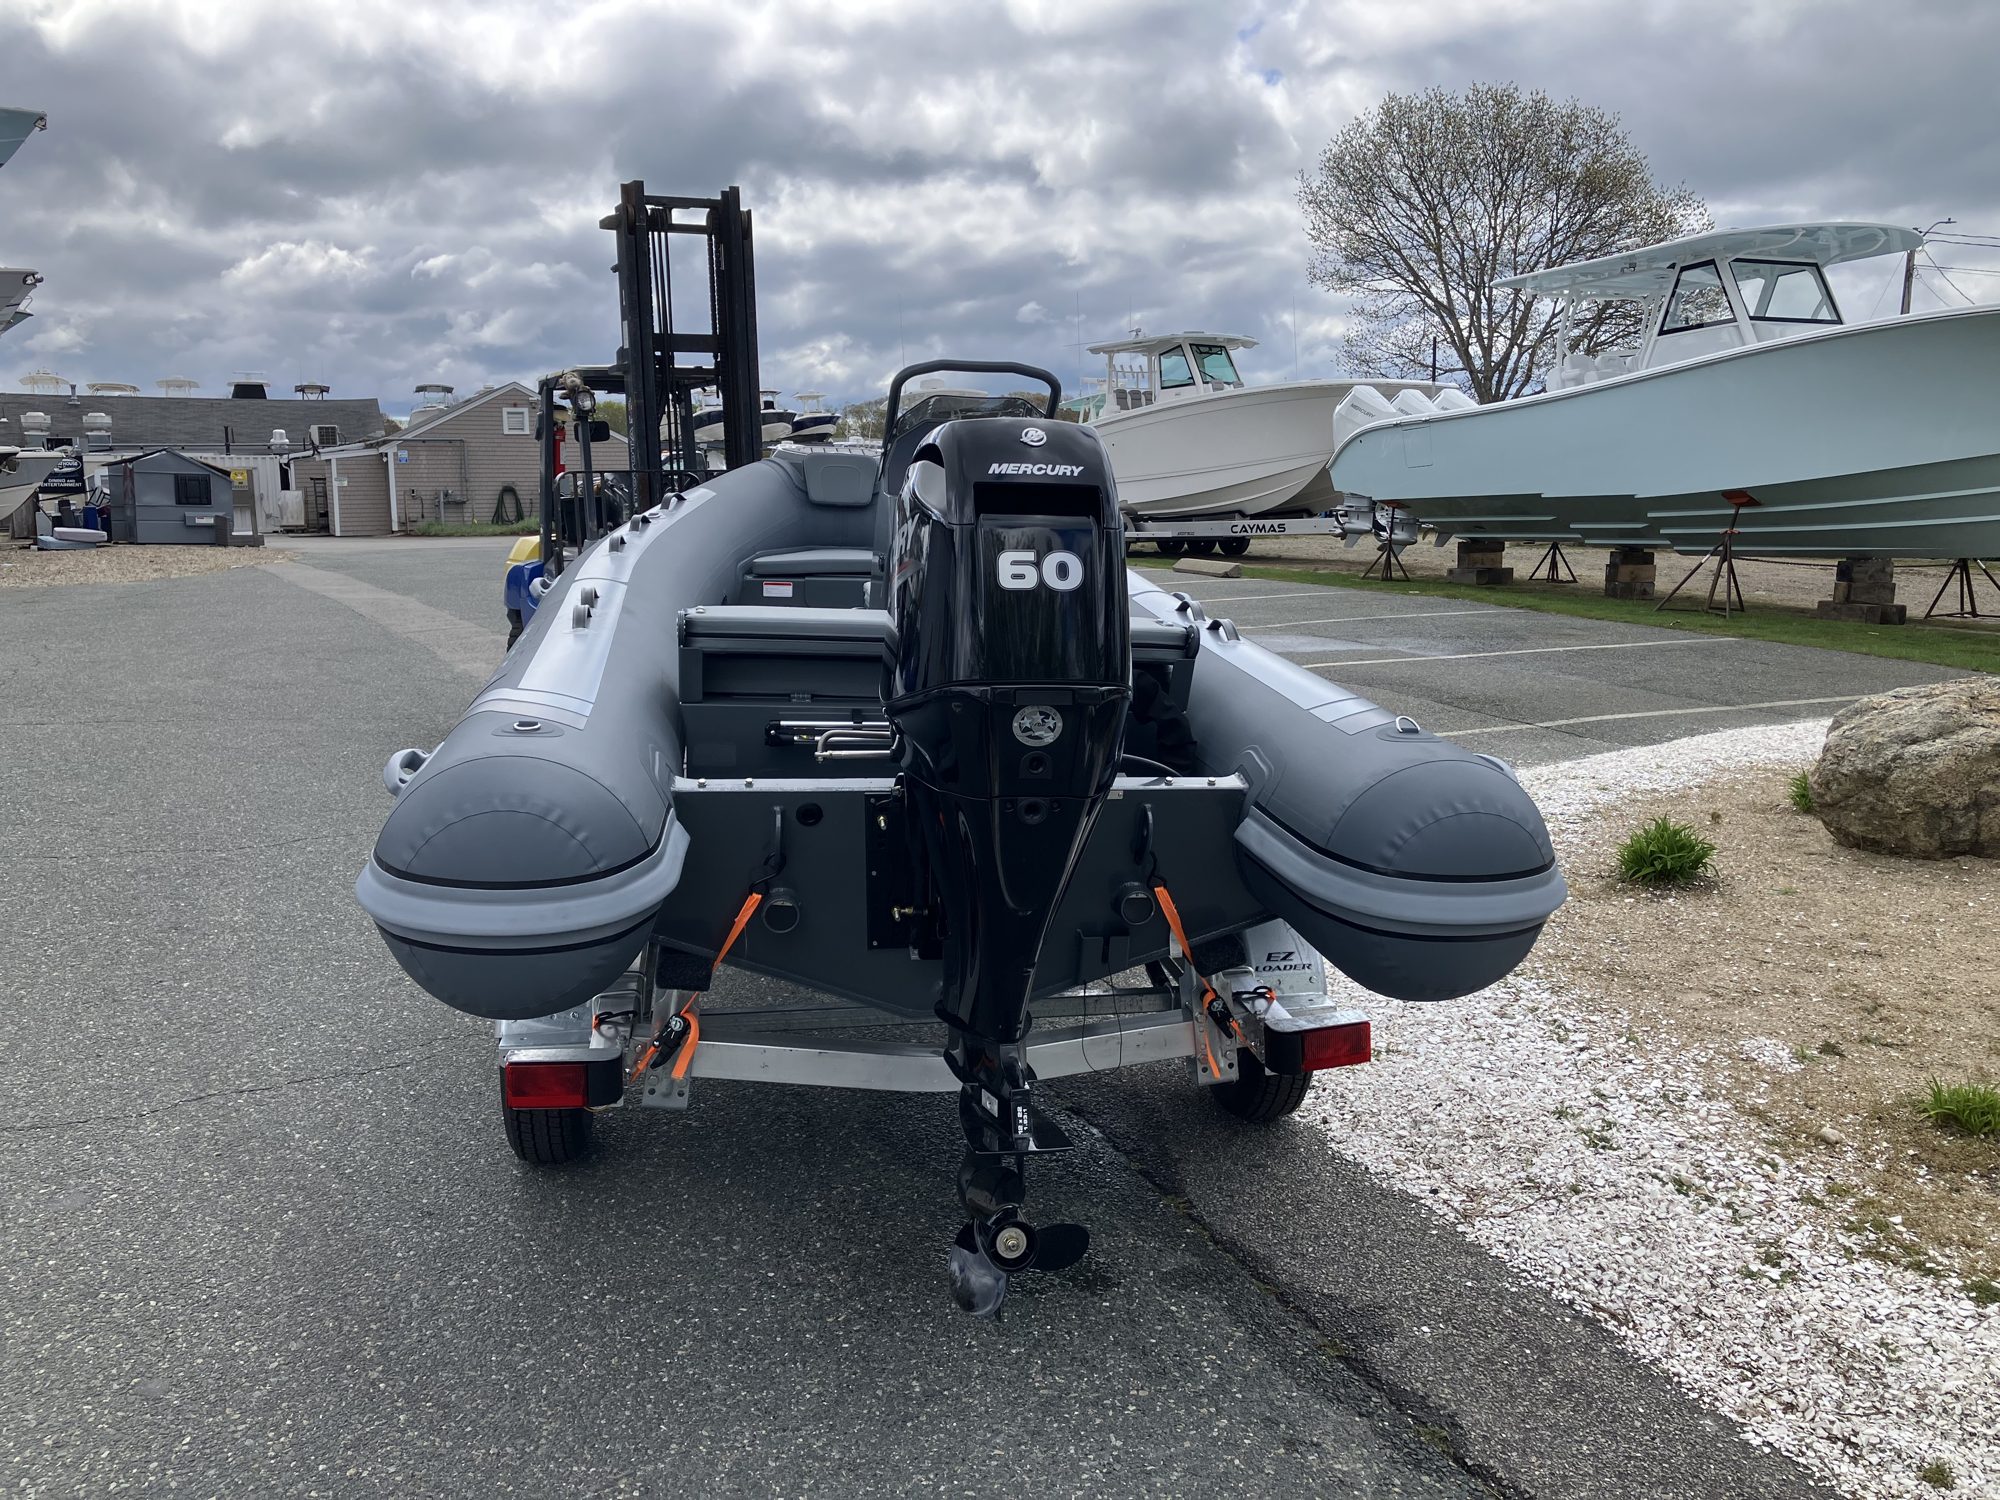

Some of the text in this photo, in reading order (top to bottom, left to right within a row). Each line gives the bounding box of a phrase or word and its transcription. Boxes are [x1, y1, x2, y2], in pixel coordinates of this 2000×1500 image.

[987, 463, 1085, 477] MERCURY
[1230, 523, 1286, 534] CAYMAS
[997, 550, 1085, 592] 60
[1265, 951, 1295, 962] EZ
[1255, 963, 1312, 973] LOADER
